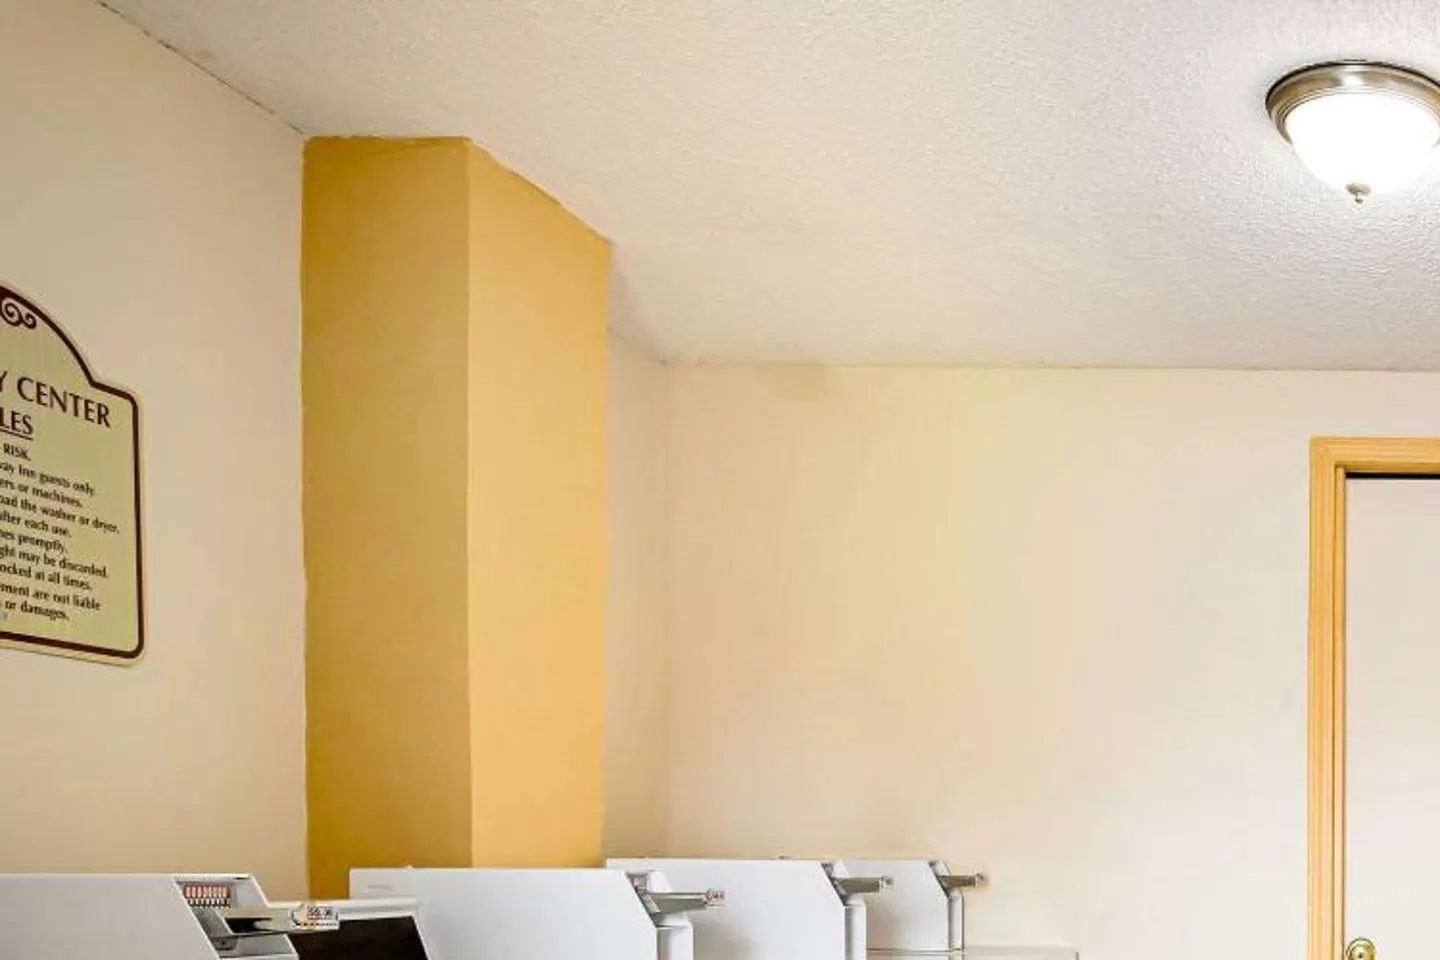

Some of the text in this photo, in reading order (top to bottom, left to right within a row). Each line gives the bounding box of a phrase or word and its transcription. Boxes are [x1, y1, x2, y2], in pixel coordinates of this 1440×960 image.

[17, 376, 110, 428] CENTER
[21, 498, 37, 513] the
[40, 506, 76, 522] washer
[25, 519, 49, 532] each
[19, 550, 41, 565] may
[44, 553, 56, 566] be
[48, 571, 60, 584] all
